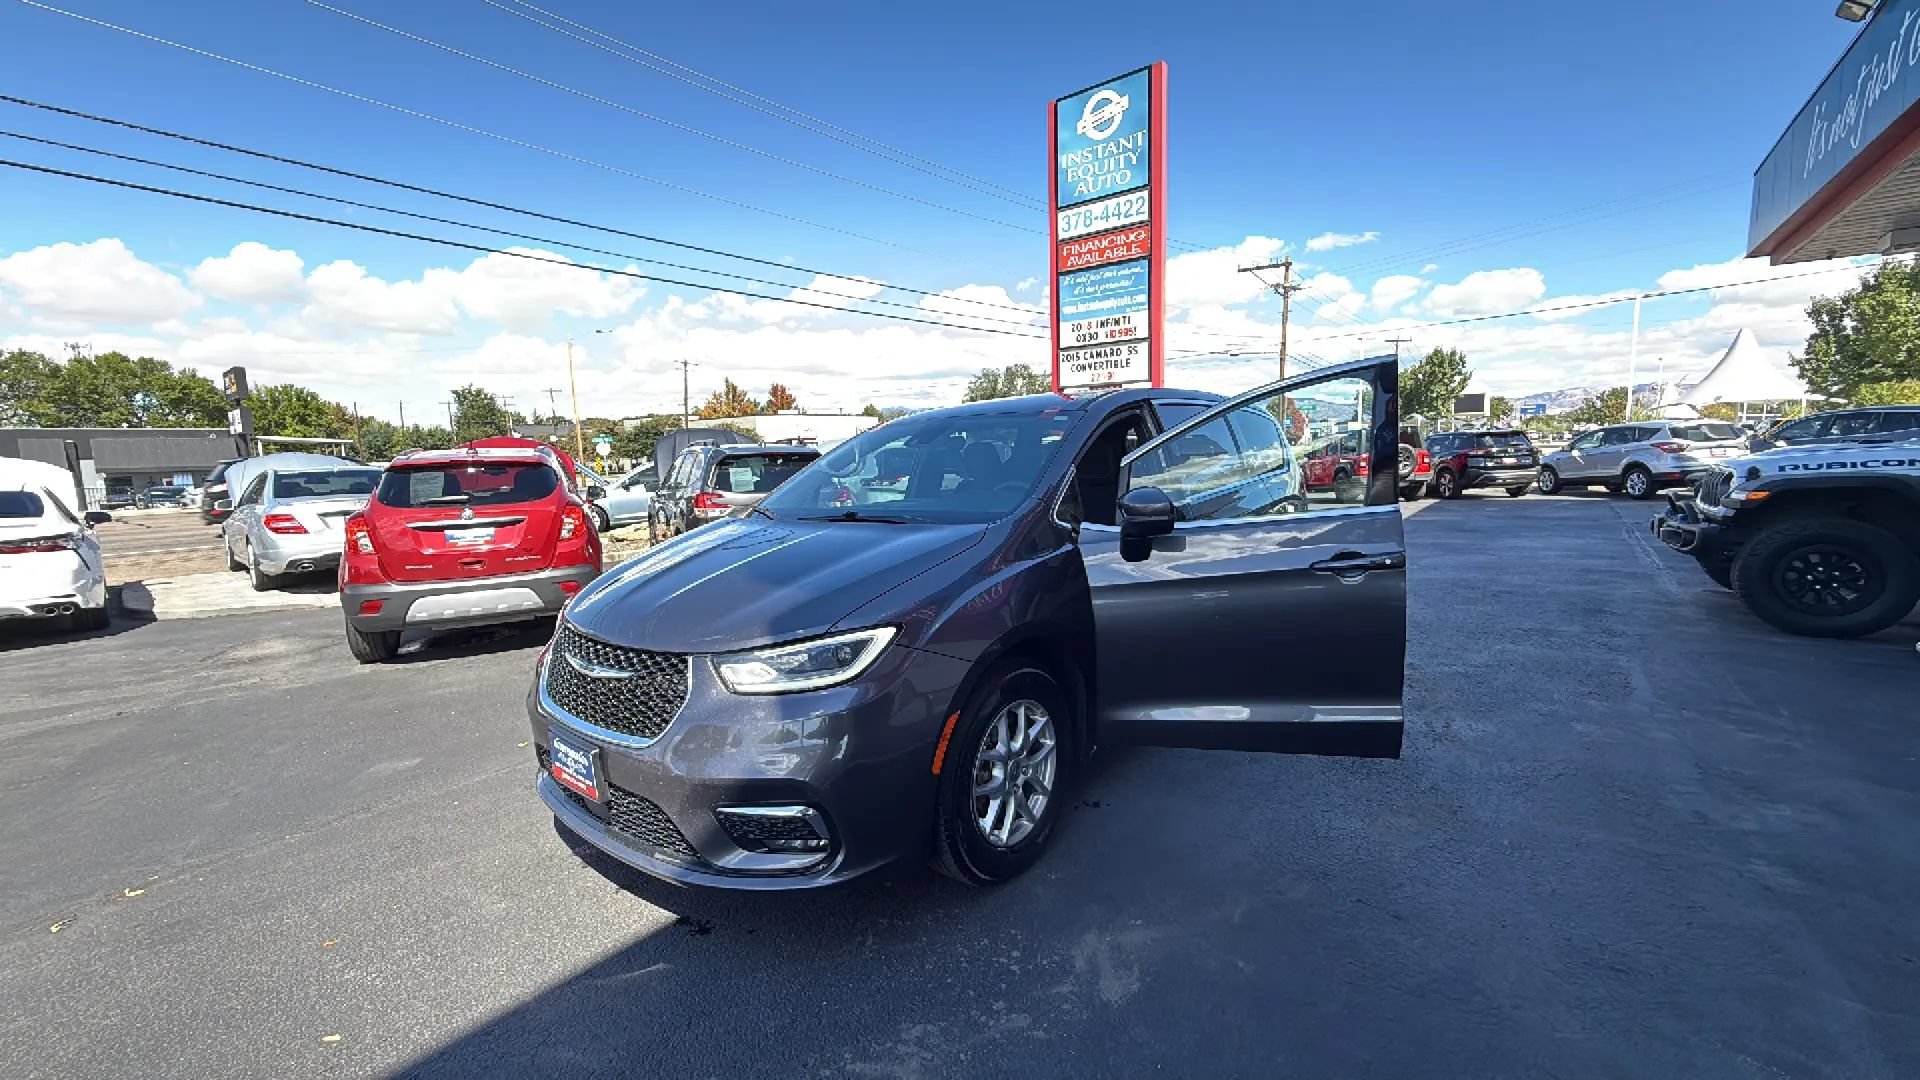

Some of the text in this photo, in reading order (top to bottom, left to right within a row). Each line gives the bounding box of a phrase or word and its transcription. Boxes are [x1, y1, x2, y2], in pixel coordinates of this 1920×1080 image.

[1803, 100, 1827, 180] It's
[1850, 7, 1919, 149] just
[1061, 130, 1147, 169] INSTANT
[1067, 149, 1141, 183] EQUITY
[1073, 169, 1132, 197] AUTO
[1061, 195, 1146, 233] 378-4422
[1062, 230, 1147, 257] FINANCING
[1066, 243, 1143, 267] AVAILABLE
[1061, 345, 1139, 363] 2015 CAMARO SS
[1070, 358, 1131, 373] CONVERTIBLE
